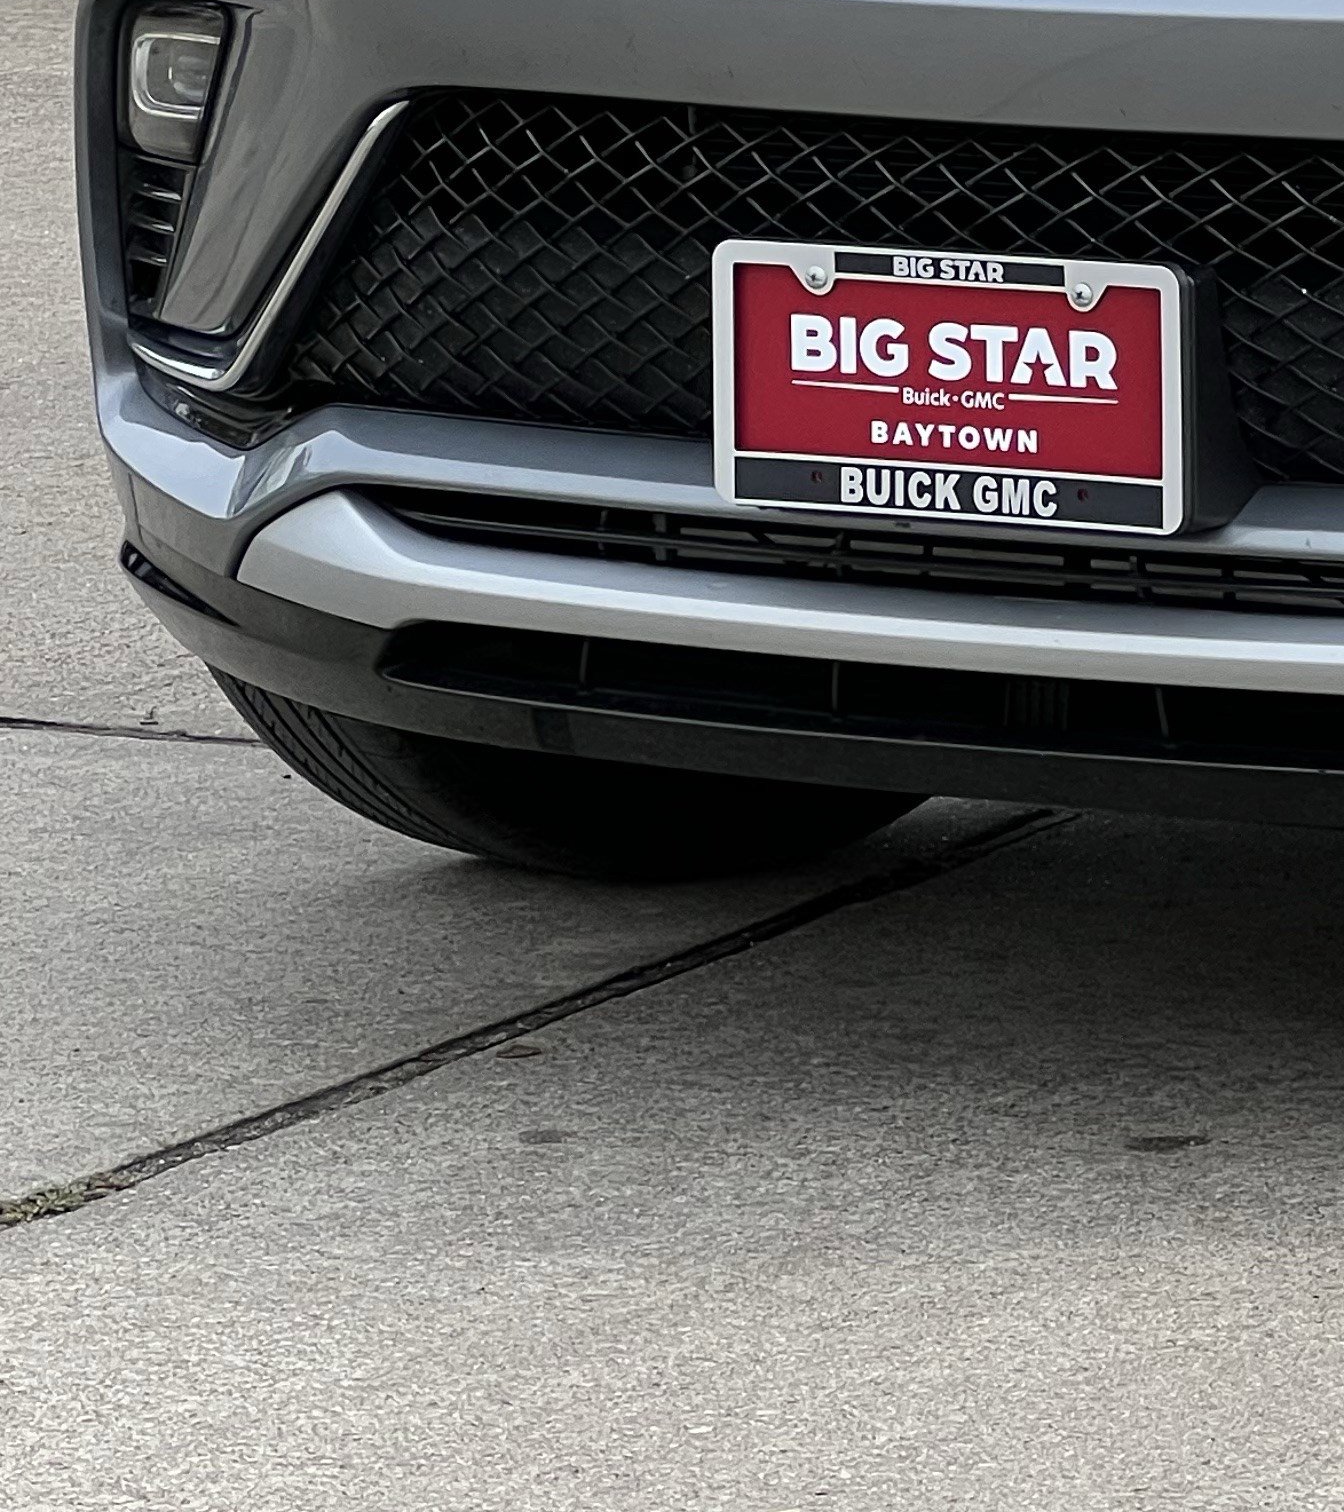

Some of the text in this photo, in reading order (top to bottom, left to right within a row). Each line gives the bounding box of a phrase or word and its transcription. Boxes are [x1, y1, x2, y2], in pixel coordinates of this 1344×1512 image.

[892, 255, 1005, 284] BIG STAR
[790, 313, 1119, 391] BIG STAR
[902, 386, 1006, 411] Buick GMC
[870, 420, 1039, 455] BAYTOWN
[839, 466, 1060, 518] BUICK GMC
